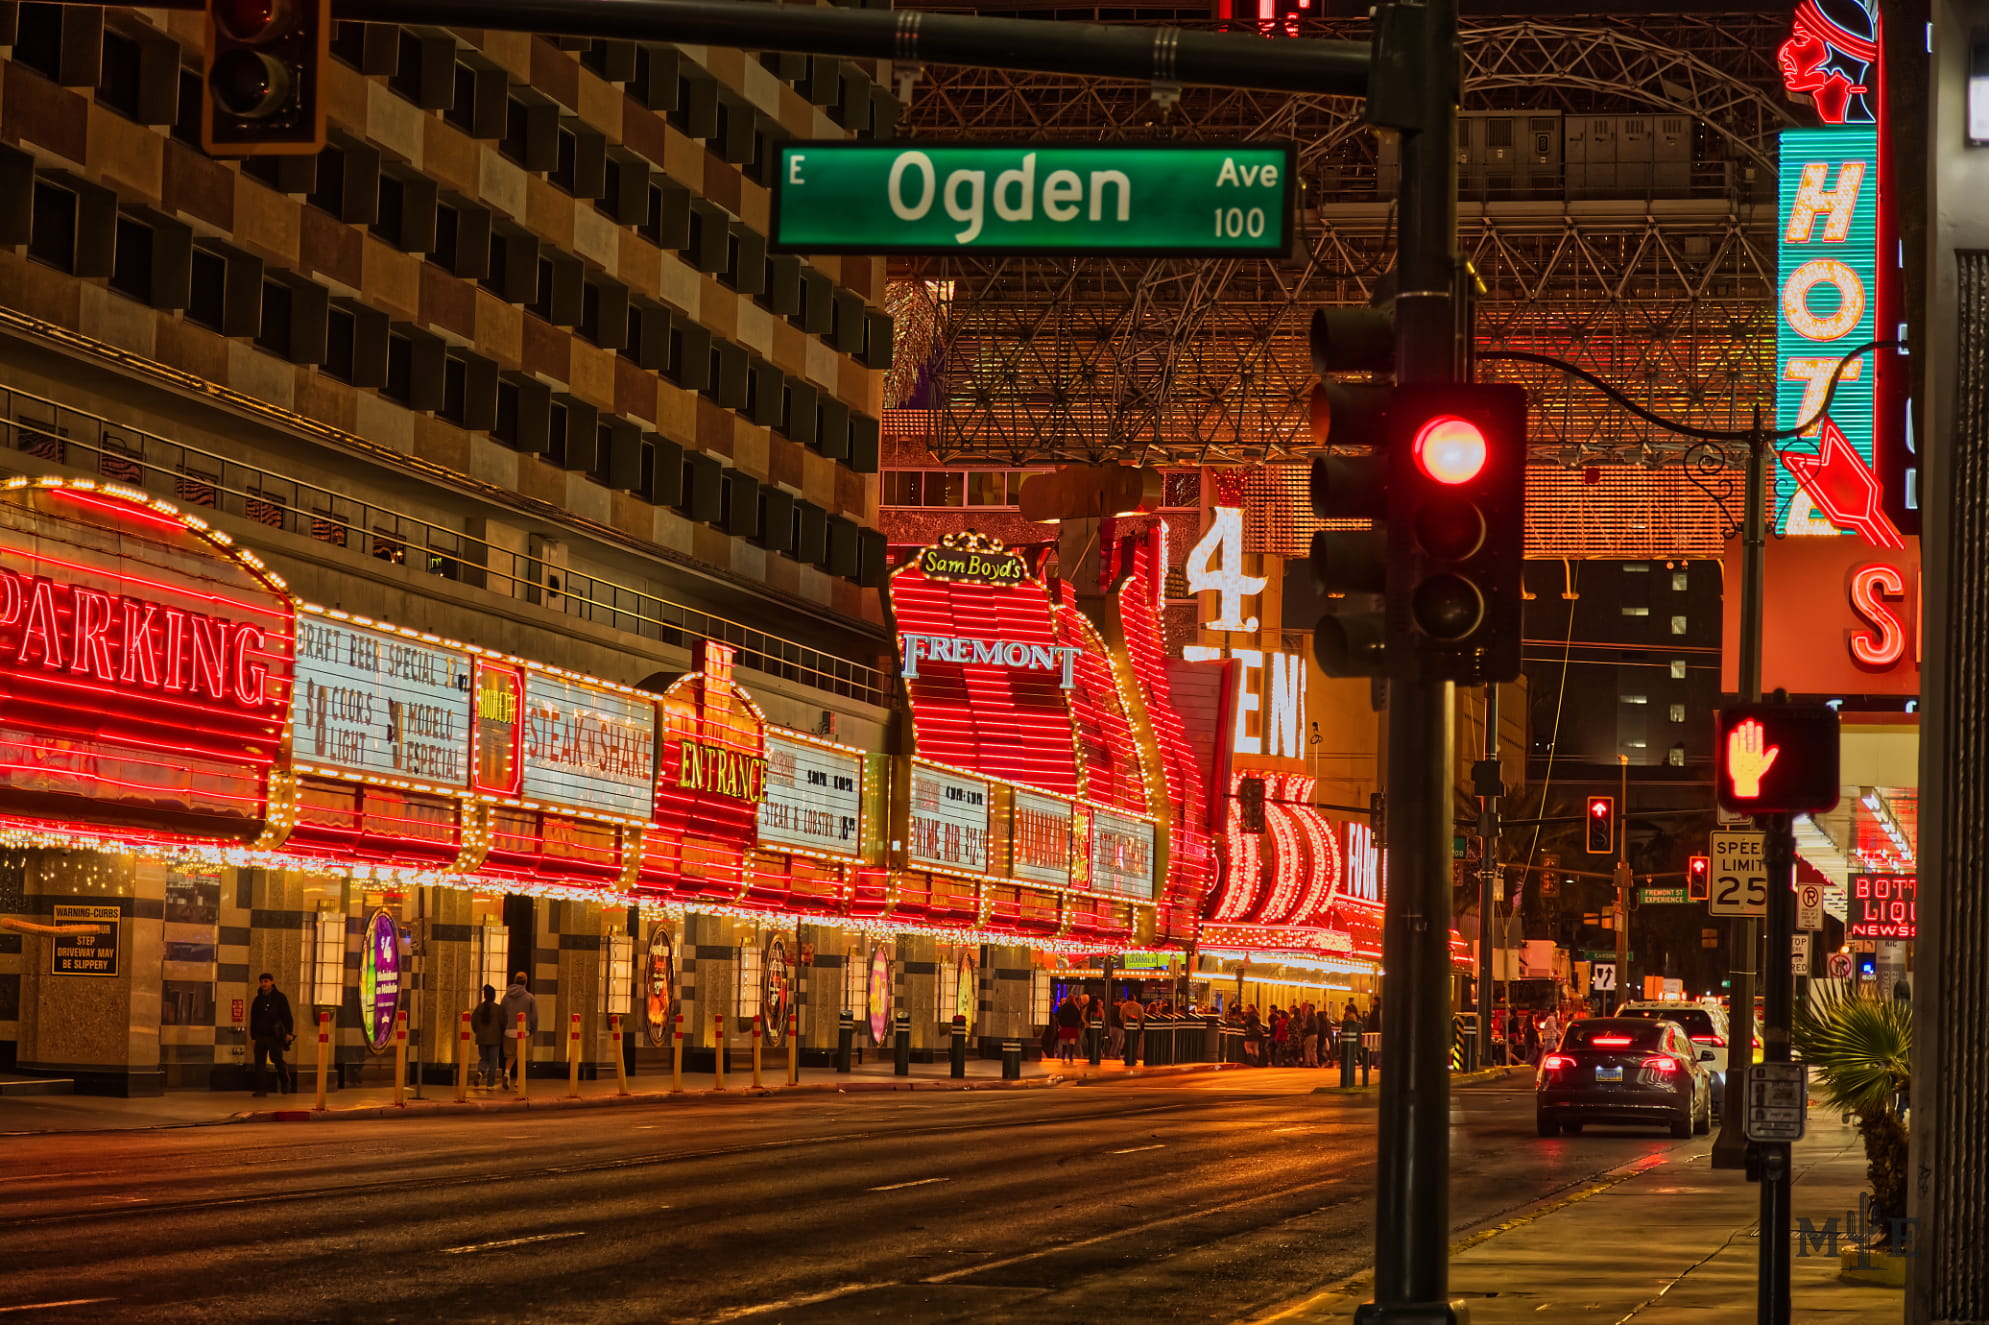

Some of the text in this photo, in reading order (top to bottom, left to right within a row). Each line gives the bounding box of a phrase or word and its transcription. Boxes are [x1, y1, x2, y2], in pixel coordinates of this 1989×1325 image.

[789, 150, 1279, 244] E Ogden Ave
[1215, 207, 1265, 239] 100
[925, 551, 1021, 580] Sam Boyd's
[1187, 506, 1269, 633] 4
[1851, 564, 1920, 665] S
[297, 621, 341, 664] DRAFT
[350, 633, 380, 674] BEER
[388, 643, 437, 687] SPECIAL
[901, 633, 1082, 689] FREMONT
[331, 685, 372, 726] COORS
[408, 702, 454, 741] MODELO
[1184, 645, 1307, 761] ENS
[329, 727, 367, 766] LIGHT
[406, 741, 460, 781] ESPECIAL
[528, 707, 585, 767] STEAK
[599, 723, 652, 780] SHAKE
[680, 741, 769, 804] ENTRANCE
[764, 800, 789, 830] STEAK
[944, 822, 960, 863] RIB
[1716, 841, 1766, 855] SPEE
[1717, 876, 1766, 906] 25
[57, 947, 114, 957] DRIVEWAY MAY
[77, 936, 95, 945] STEP
[62, 959, 108, 969] BE SLIPPERY
